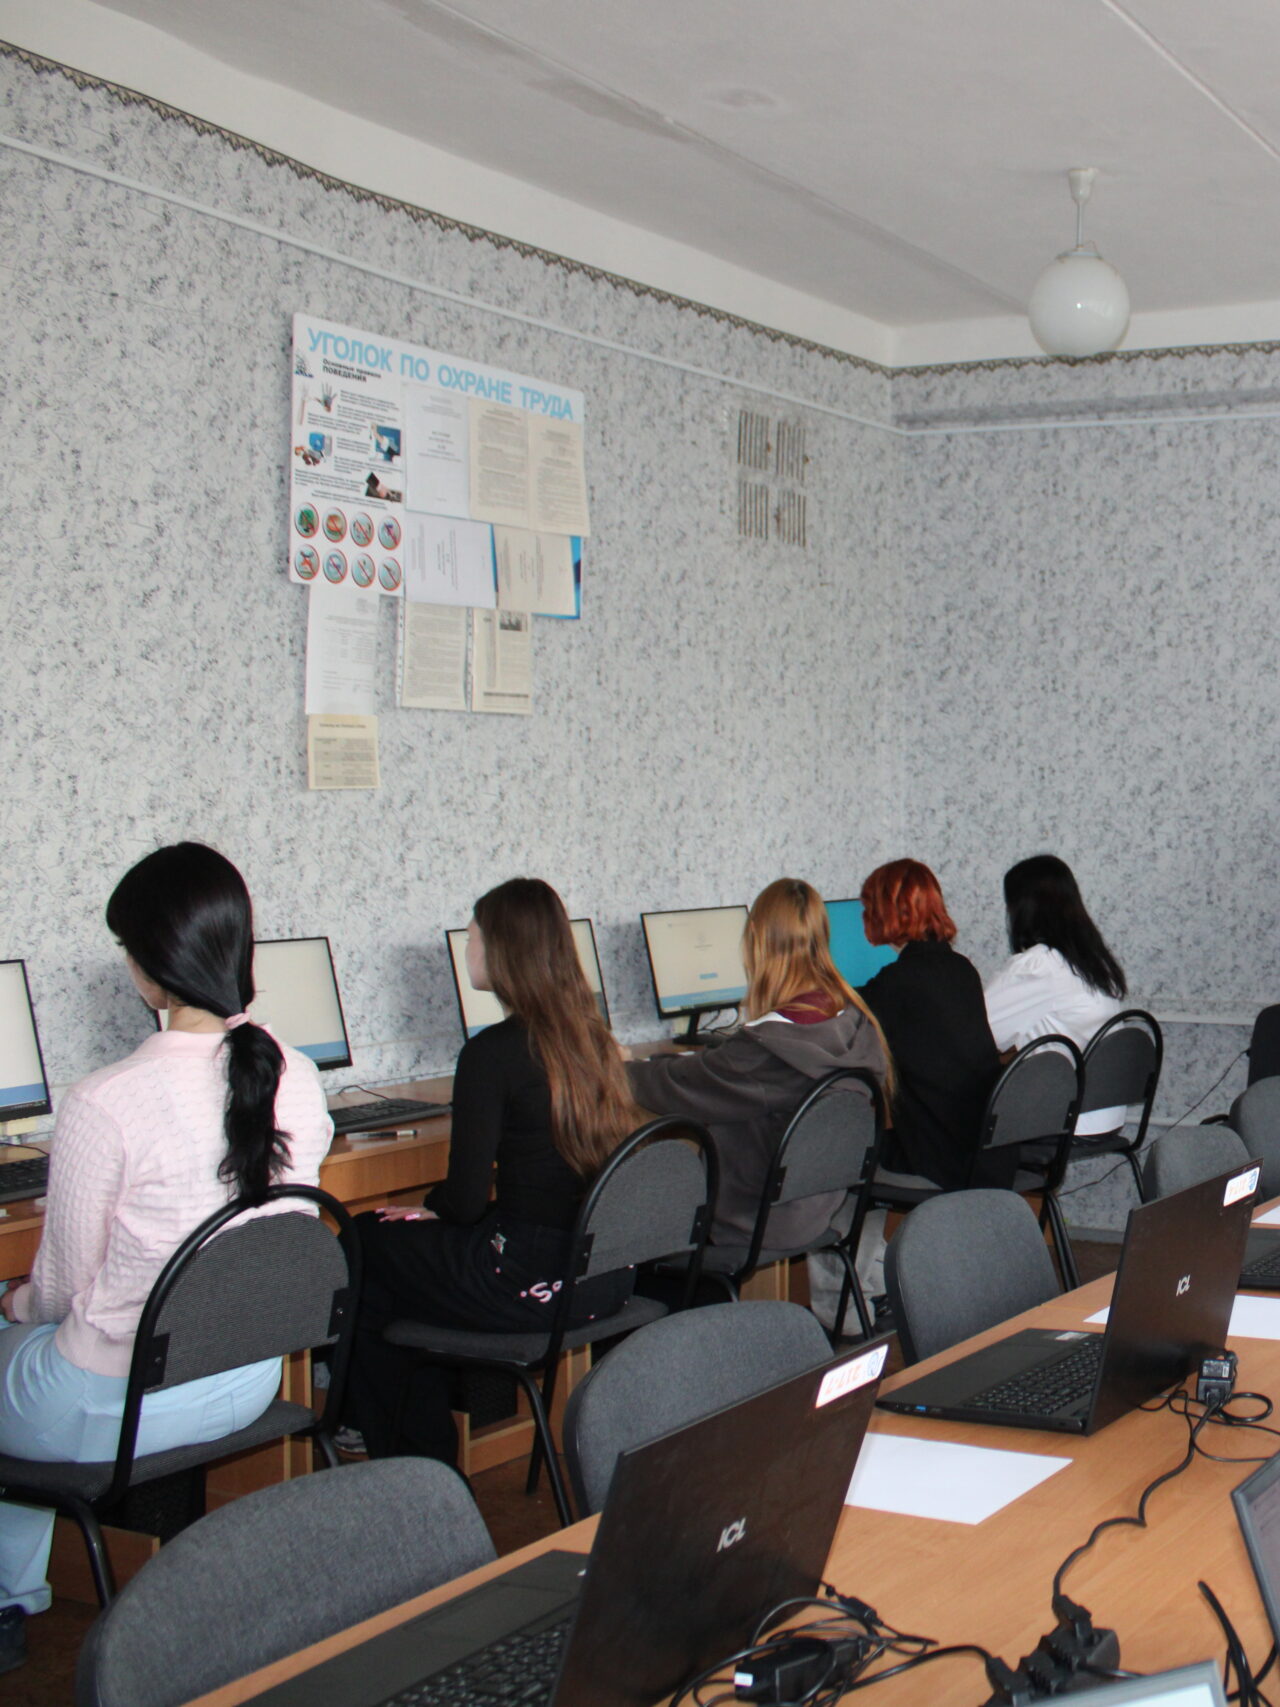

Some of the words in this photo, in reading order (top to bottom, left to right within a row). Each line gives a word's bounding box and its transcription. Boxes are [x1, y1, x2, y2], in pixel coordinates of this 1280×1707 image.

[307, 327, 392, 372] УГОЛОК
[400, 353, 430, 382] ПО
[437, 364, 513, 404] ОХРАНЕ
[519, 386, 575, 421] ТРУДА
[322, 365, 367, 382] ПОВЕДЕНИЯ
[1176, 1274, 1190, 1296] ICL
[716, 1517, 746, 1552] ICL
